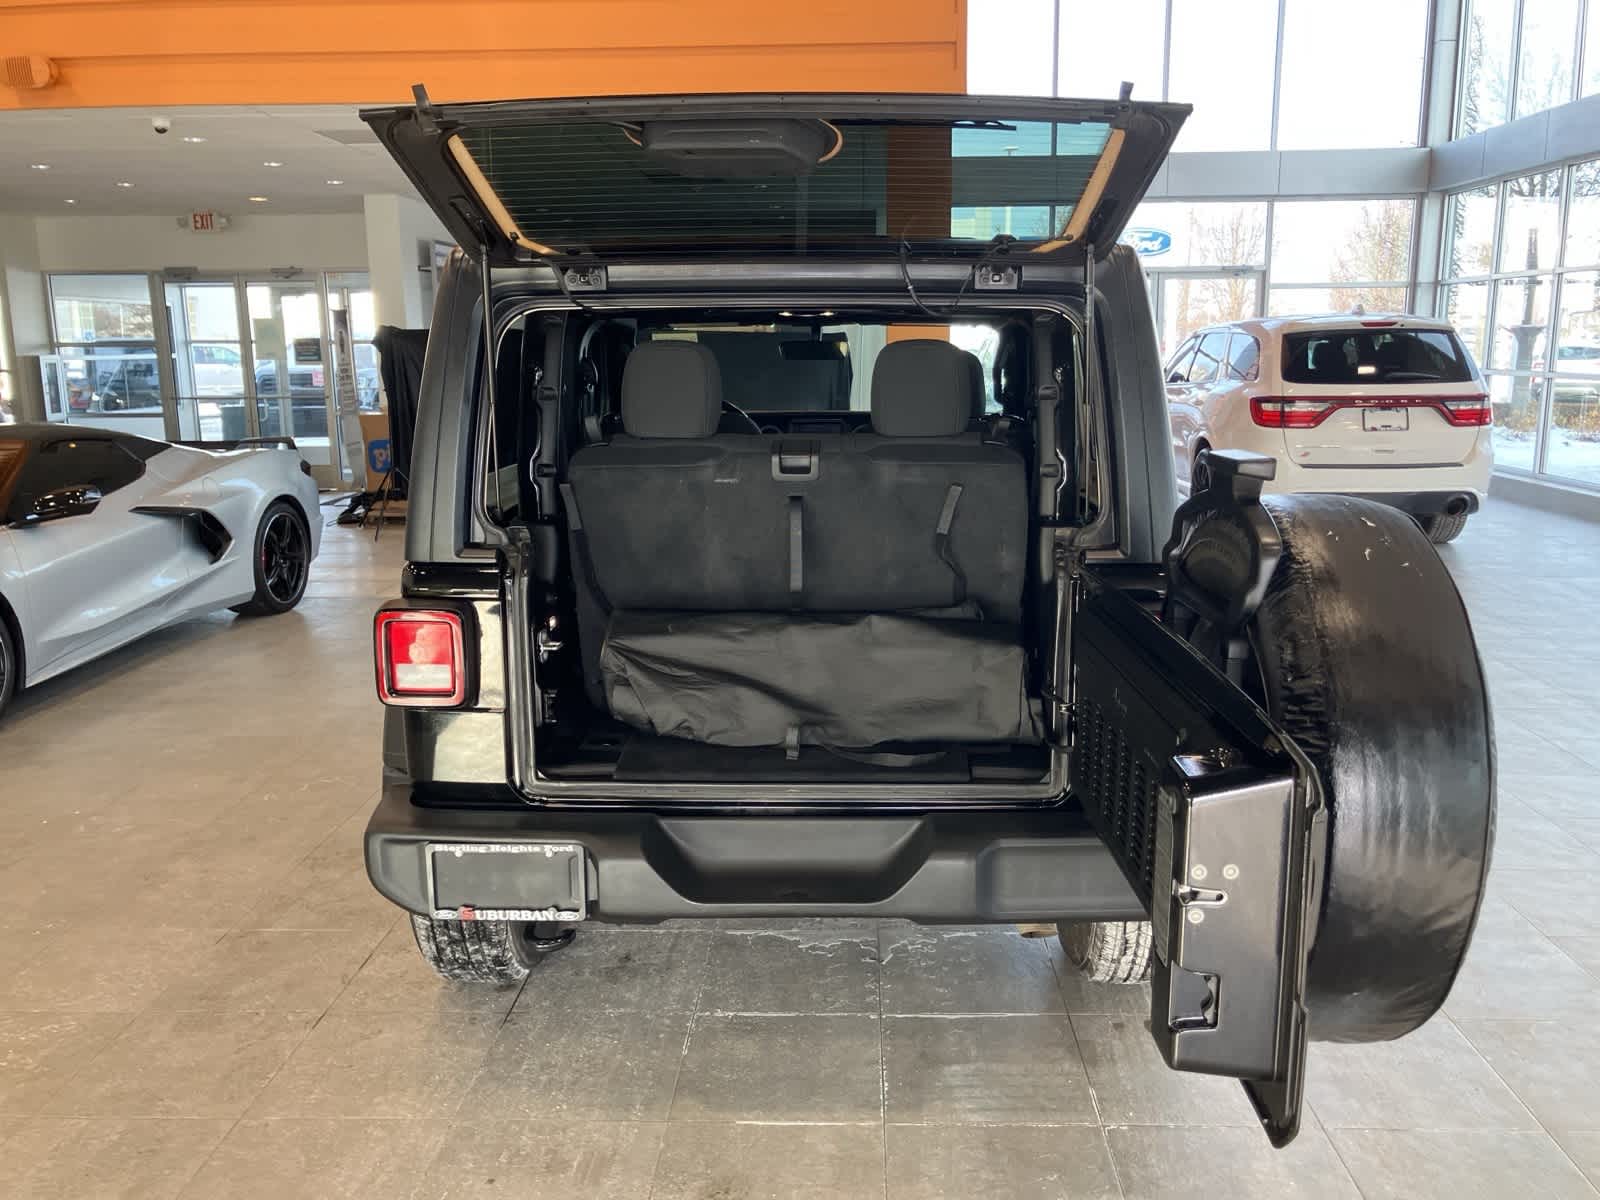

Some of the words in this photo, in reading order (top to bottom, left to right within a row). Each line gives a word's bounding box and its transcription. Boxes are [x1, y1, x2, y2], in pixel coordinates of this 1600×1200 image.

[193, 213, 214, 230] EXIT
[1123, 232, 1164, 251] Ford
[487, 844, 541, 853] Heights
[543, 844, 574, 853] Ford
[460, 906, 554, 921] SUBURBAN
